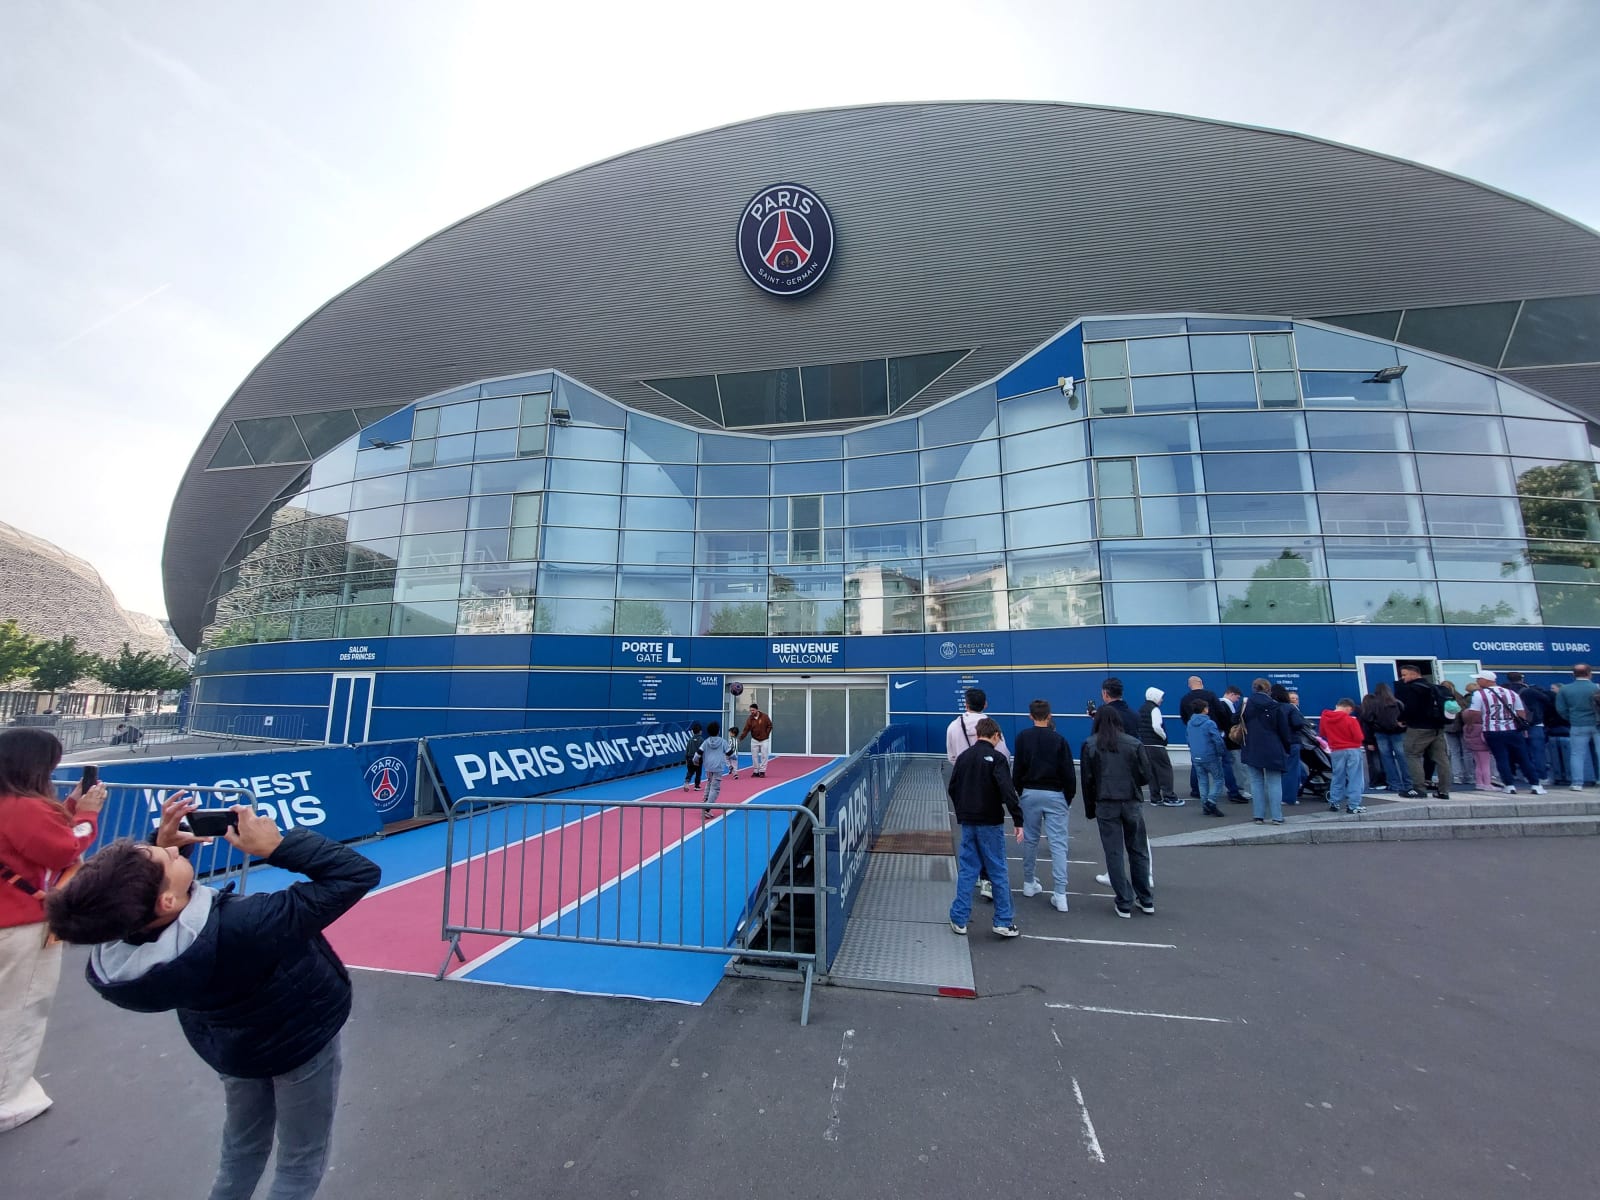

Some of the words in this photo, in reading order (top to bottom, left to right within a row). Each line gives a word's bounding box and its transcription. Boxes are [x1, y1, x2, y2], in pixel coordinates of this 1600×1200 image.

[750, 191, 814, 221] PARIS
[348, 645, 369, 654] SALON
[621, 641, 663, 653] PORTE
[667, 642, 682, 663] L
[772, 642, 839, 654] BIENVENUE
[1472, 641, 1544, 652] CONCIERGERIE
[1551, 643, 1565, 652] DU
[1566, 643, 1591, 653] PARC
[339, 653, 351, 661] DES
[351, 652, 376, 661] PRINCES
[636, 653, 663, 663] GATE
[779, 654, 833, 664] WELCOME
[696, 676, 718, 684] QATAR
[454, 747, 565, 790] PARIS
[565, 729, 695, 771] SAINT-GERMA
[370, 759, 402, 774] PARIS
[838, 777, 869, 875] PARIS
